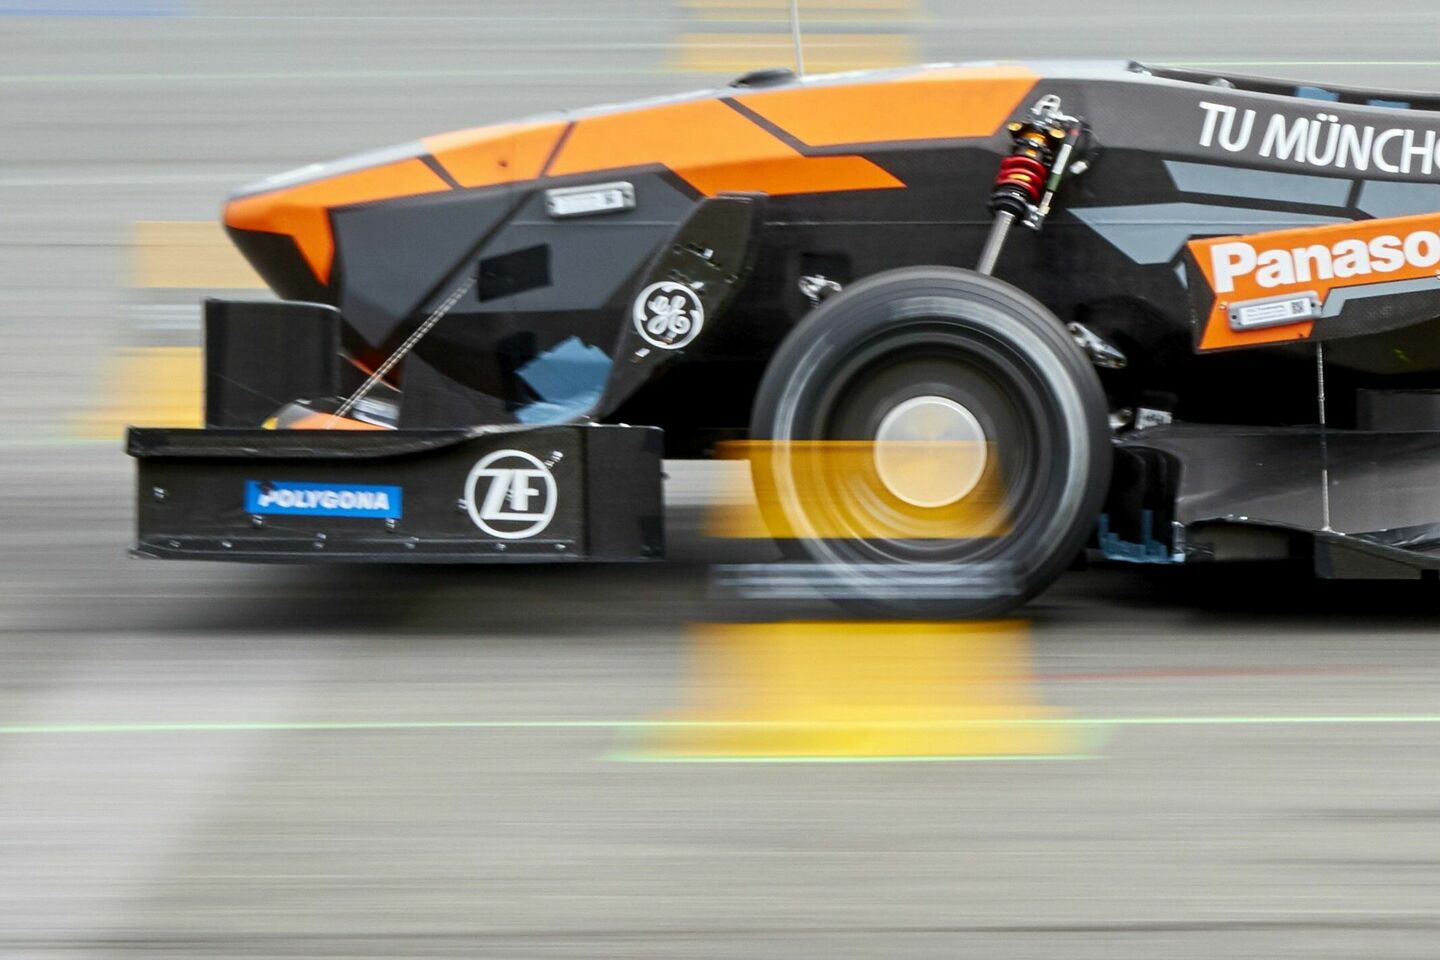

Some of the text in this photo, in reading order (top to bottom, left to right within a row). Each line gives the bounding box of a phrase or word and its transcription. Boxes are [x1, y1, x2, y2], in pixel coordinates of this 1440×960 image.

[1199, 101, 1256, 153] TU
[258, 489, 391, 511] POLYGONA
[471, 466, 551, 522] ZF
